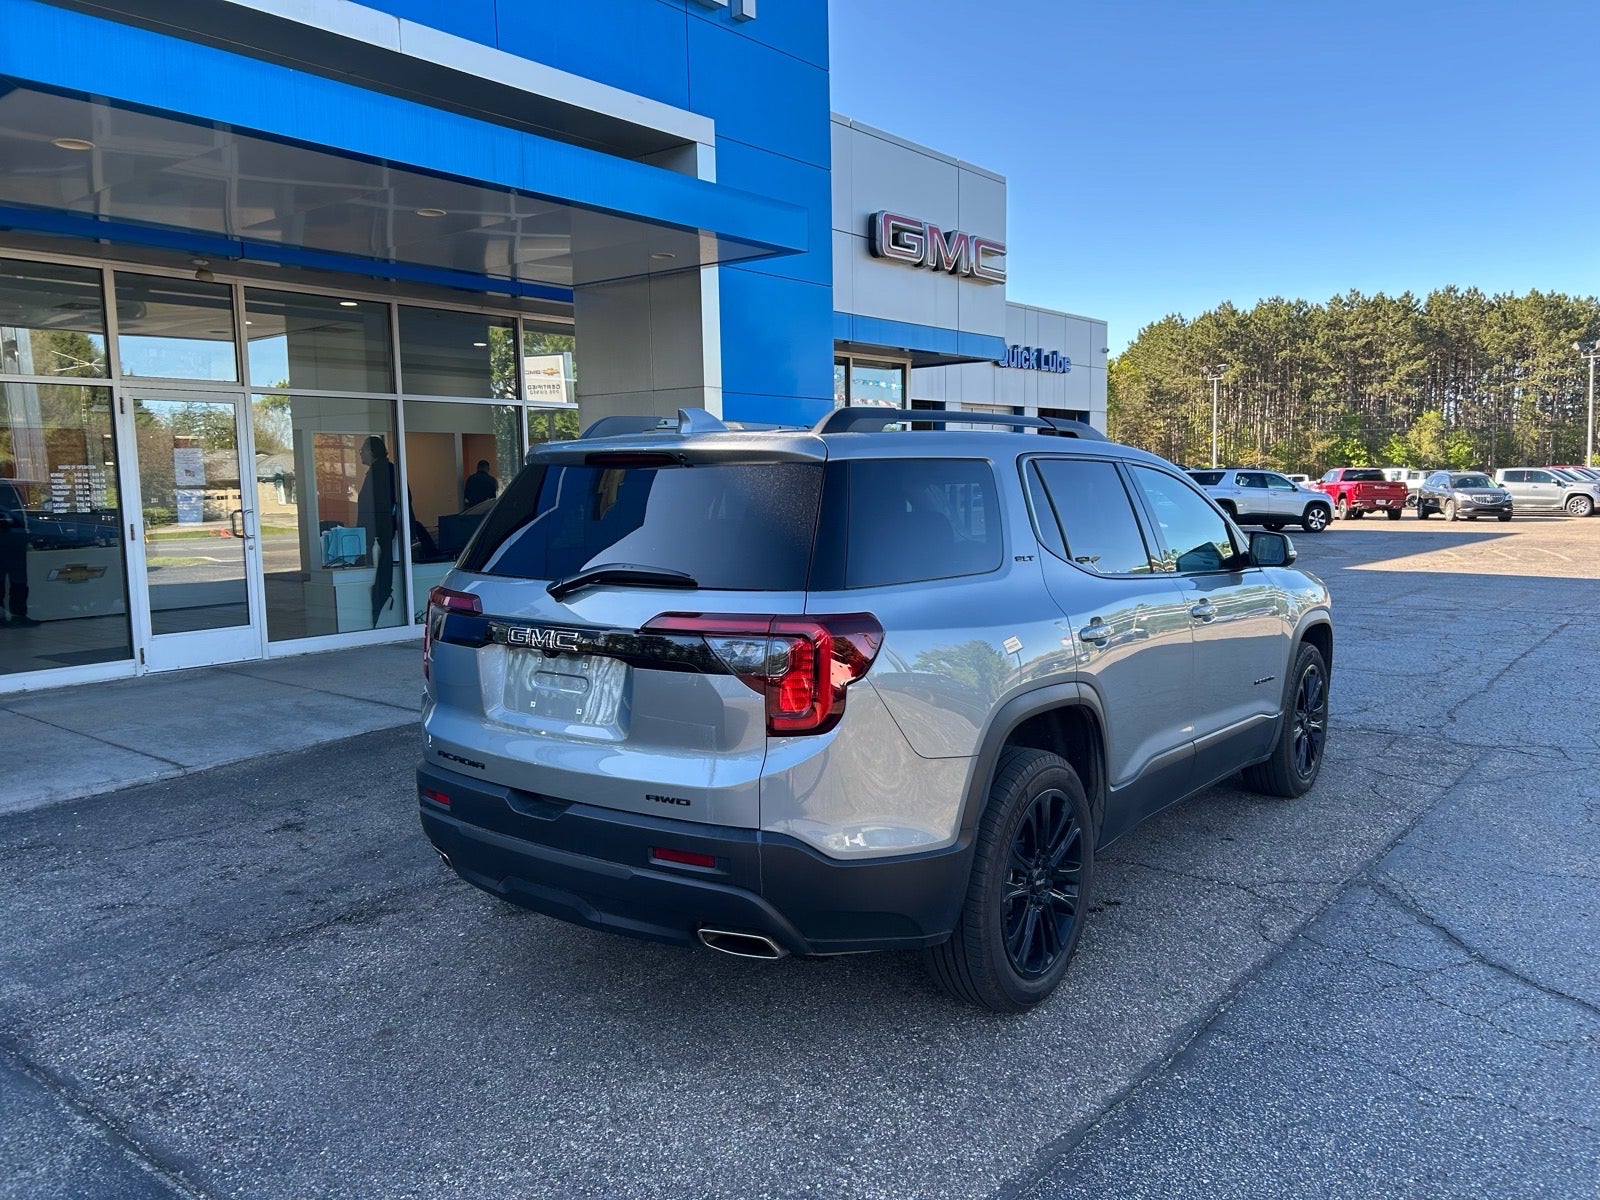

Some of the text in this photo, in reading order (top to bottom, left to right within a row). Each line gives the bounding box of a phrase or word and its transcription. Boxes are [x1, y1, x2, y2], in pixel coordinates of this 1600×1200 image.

[868, 210, 1007, 285] GMC
[1040, 348, 1072, 373] Lube
[508, 626, 578, 652] GMC
[437, 750, 486, 770] ACADIA
[645, 794, 691, 807] AWD
